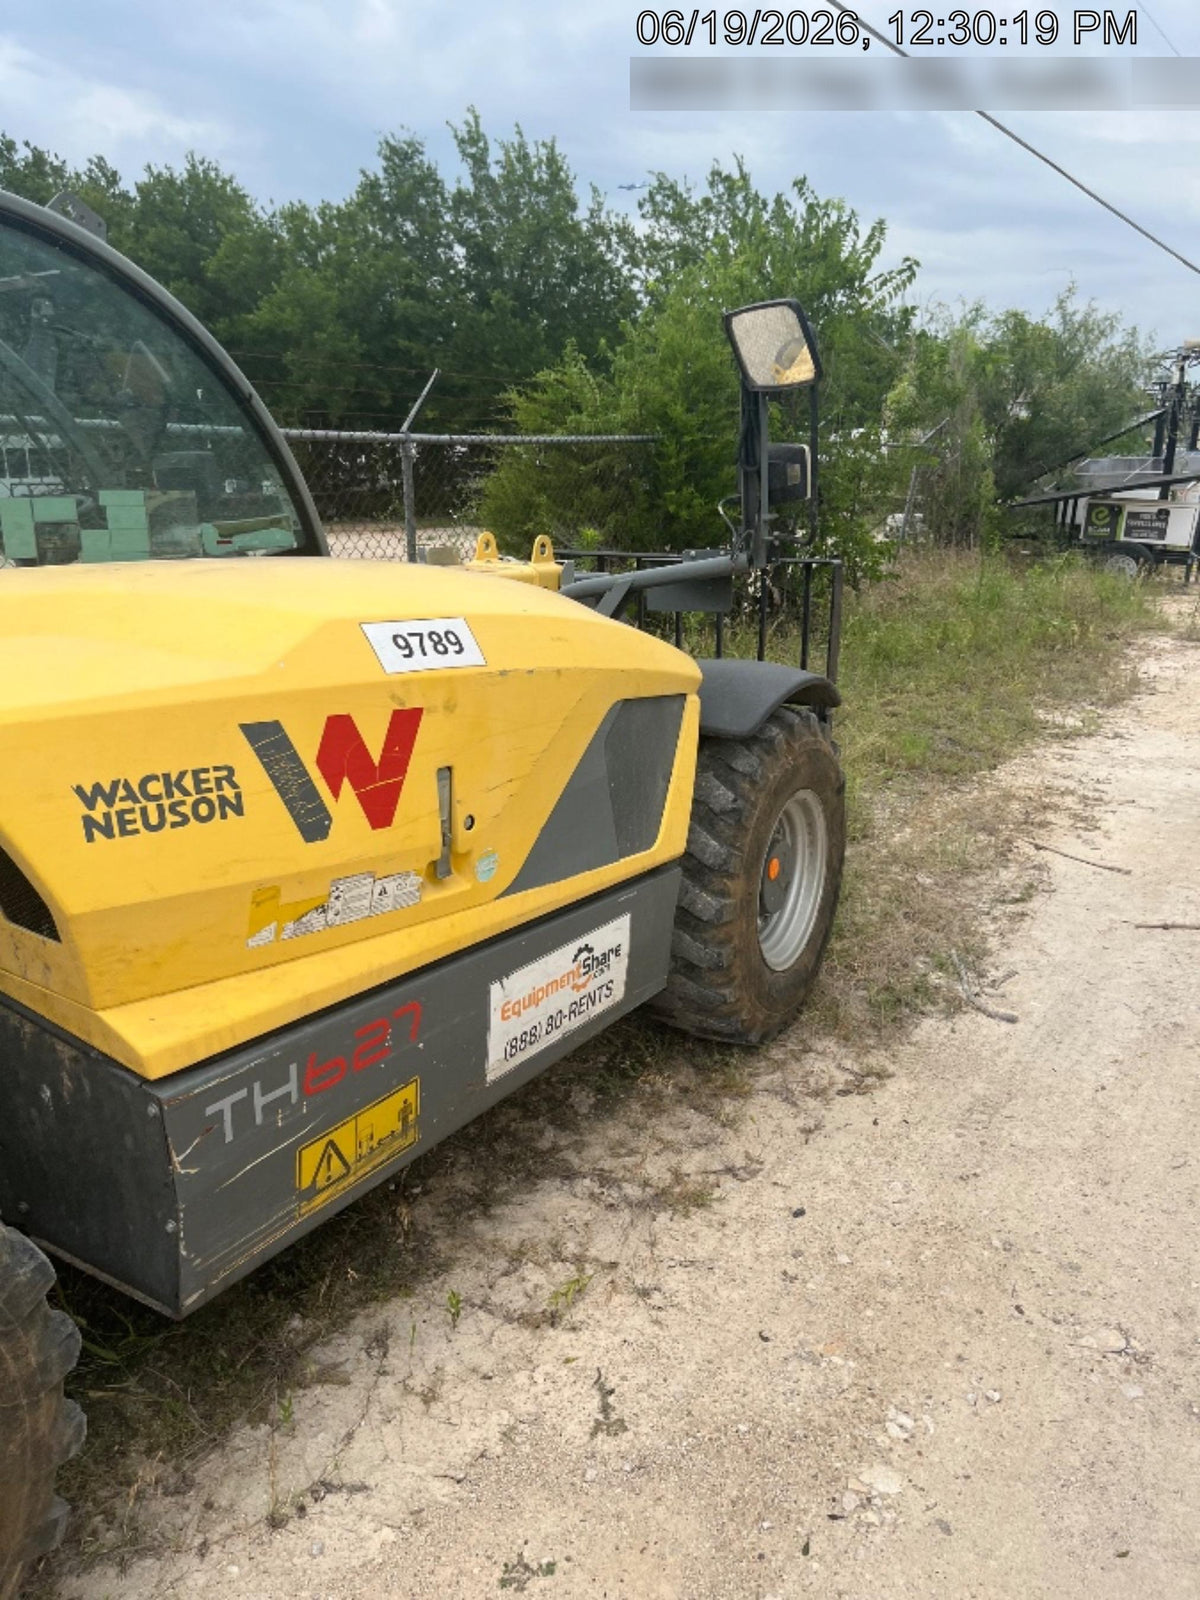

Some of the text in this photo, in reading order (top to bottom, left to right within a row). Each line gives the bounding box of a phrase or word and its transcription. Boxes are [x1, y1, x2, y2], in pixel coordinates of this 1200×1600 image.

[392, 629, 466, 659] 9789
[72, 764, 240, 812] WACKER
[81, 791, 245, 843] NEUSON
[504, 979, 615, 1062] (888) 80-RENTS
[205, 1000, 424, 1144] TH627
